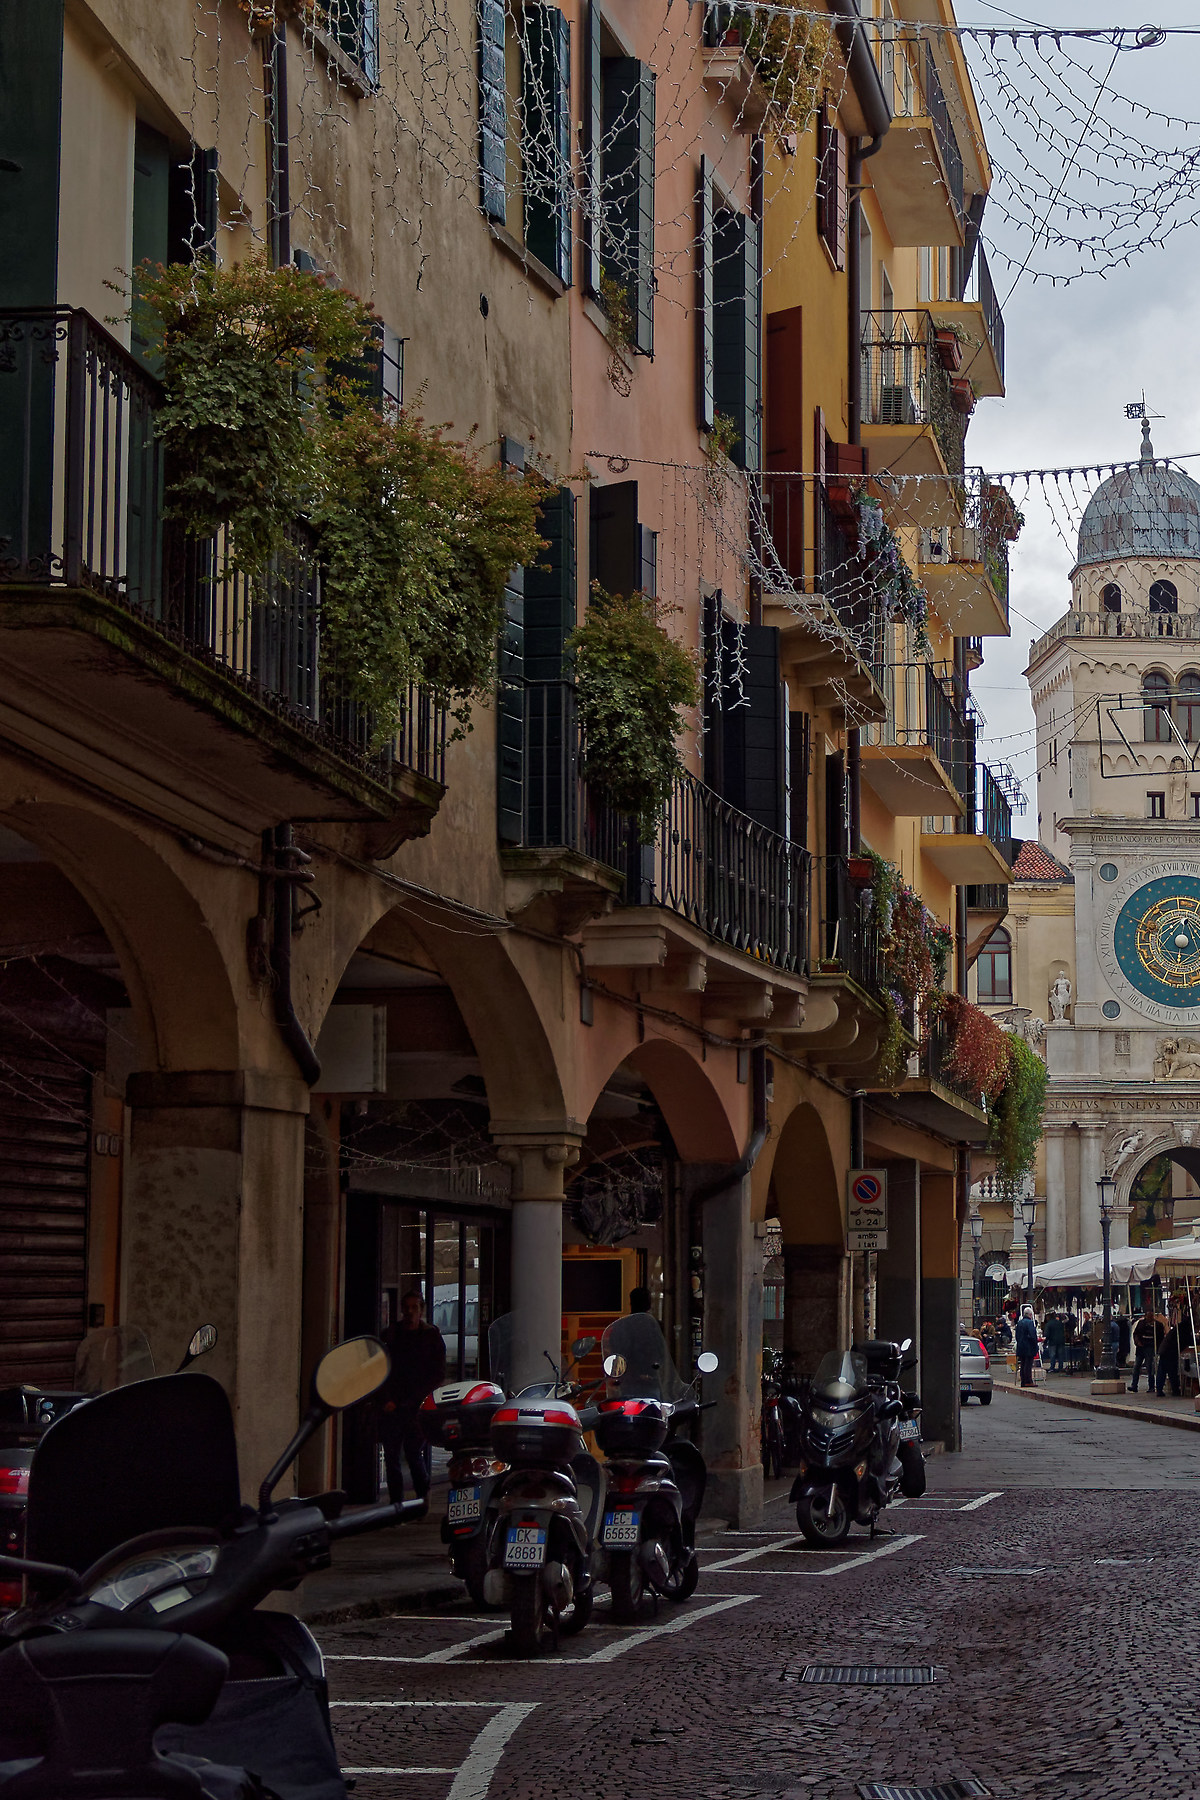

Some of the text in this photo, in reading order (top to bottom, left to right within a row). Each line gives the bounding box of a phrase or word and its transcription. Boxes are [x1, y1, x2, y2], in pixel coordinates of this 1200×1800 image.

[1115, 835, 1140, 843] LANDO
[1049, 1101, 1099, 1109] SENATVS
[1112, 1101, 1161, 1110] VENETVS
[449, 1502, 479, 1518] 56166
[613, 1512, 627, 1524] EC
[516, 1529, 532, 1543] CK
[605, 1527, 637, 1540] 65633
[507, 1546, 542, 1560] 48681
